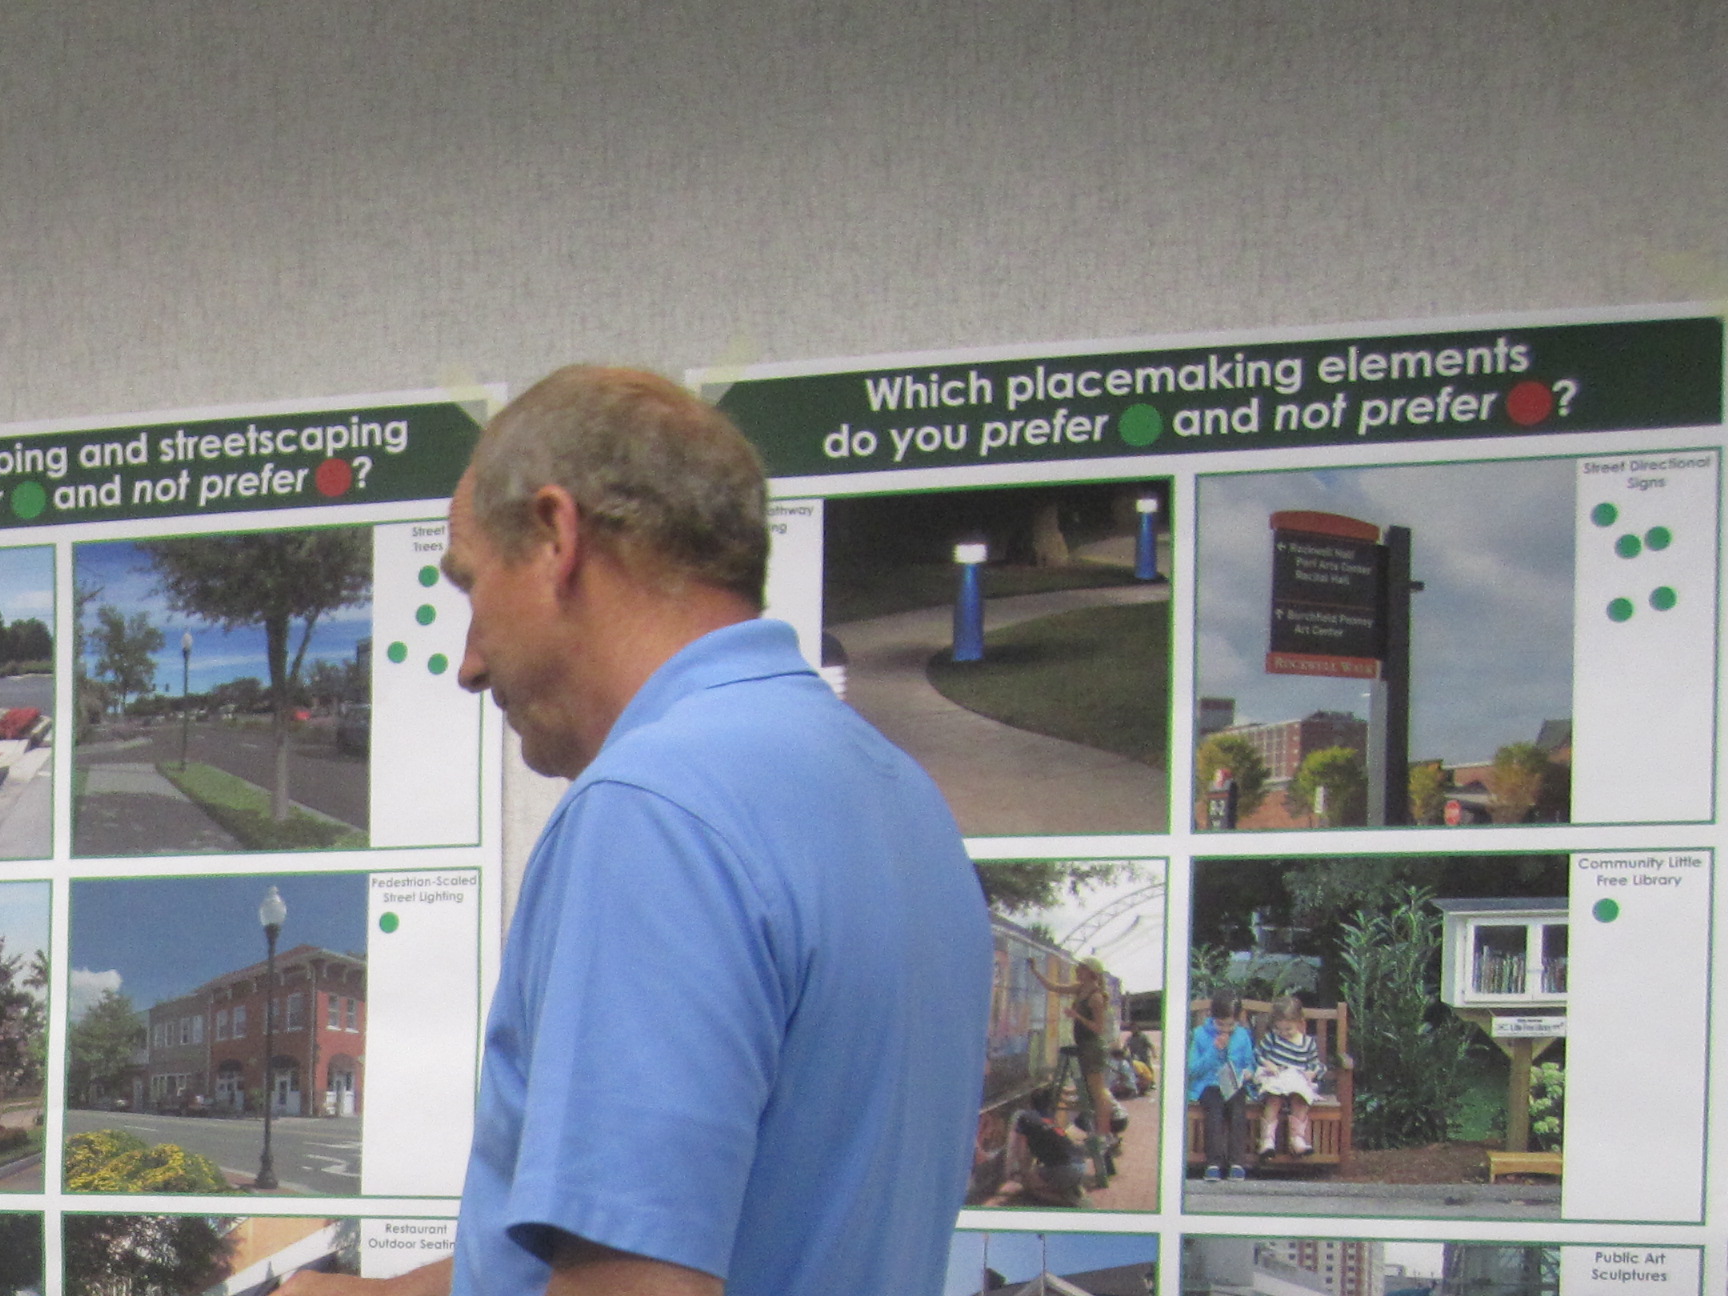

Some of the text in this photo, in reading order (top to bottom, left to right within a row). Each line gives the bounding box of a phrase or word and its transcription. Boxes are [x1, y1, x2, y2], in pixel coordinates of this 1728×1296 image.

[864, 337, 1531, 412] Which placemaking elements
[823, 379, 1578, 462] do you prefer and not prefer ?
[79, 433, 148, 469] and
[159, 415, 408, 463] streetscaping
[1583, 456, 1711, 474] Street Directional
[54, 475, 121, 510] and
[132, 470, 189, 503] not
[198, 463, 309, 506] prefer
[351, 456, 372, 488] ?
[1627, 477, 1666, 491] Signs
[766, 504, 814, 517] athway
[412, 525, 446, 537] Street
[414, 542, 444, 552] Trees
[1578, 856, 1702, 871] Community Little
[372, 875, 477, 888] Pedestrian-Scaled
[1597, 874, 1683, 887] Free Library
[383, 891, 464, 904] Street Lighting
[385, 1223, 448, 1235] Restaurant
[368, 1238, 456, 1250] Outdoor Seatin
[1595, 1252, 1667, 1265] Public Art
[1591, 1269, 1667, 1283] Sculptures
